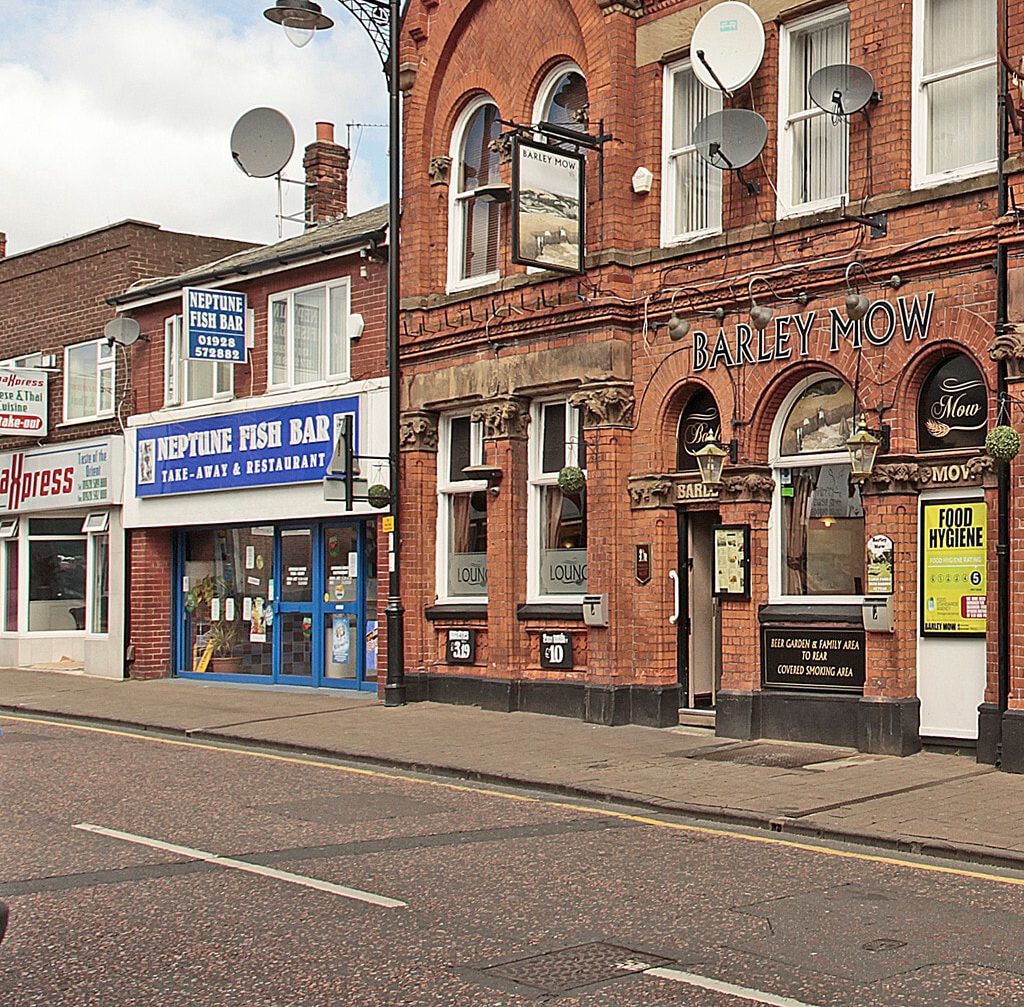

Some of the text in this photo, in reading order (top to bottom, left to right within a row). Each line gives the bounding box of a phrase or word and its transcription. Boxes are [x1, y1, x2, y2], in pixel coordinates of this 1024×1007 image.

[522, 149, 576, 170] BARLEY MOW
[190, 291, 243, 313] NEPTUNE
[190, 311, 243, 331] FISH BAR
[692, 292, 935, 372] BARLEY MOW
[198, 335, 236, 347] 01928
[195, 347, 240, 359] 572882
[24, 390, 43, 402] Thai
[0, 402, 28, 412] uisine
[931, 393, 982, 420] Mow
[157, 414, 331, 462] NEPTUNE FISH BAR
[161, 453, 326, 483] TAKE-AWAY & RESTAURANT
[939, 507, 973, 528] FOOD
[929, 527, 983, 548] HYGIENE
[457, 568, 488, 583] LOUN
[972, 573, 980, 584] 5
[770, 638, 860, 650] BEER GARDEN & FAMILY AREA
[802, 651, 828, 661] TO REAR
[777, 664, 853, 677] COVERED SMOKING AREA
